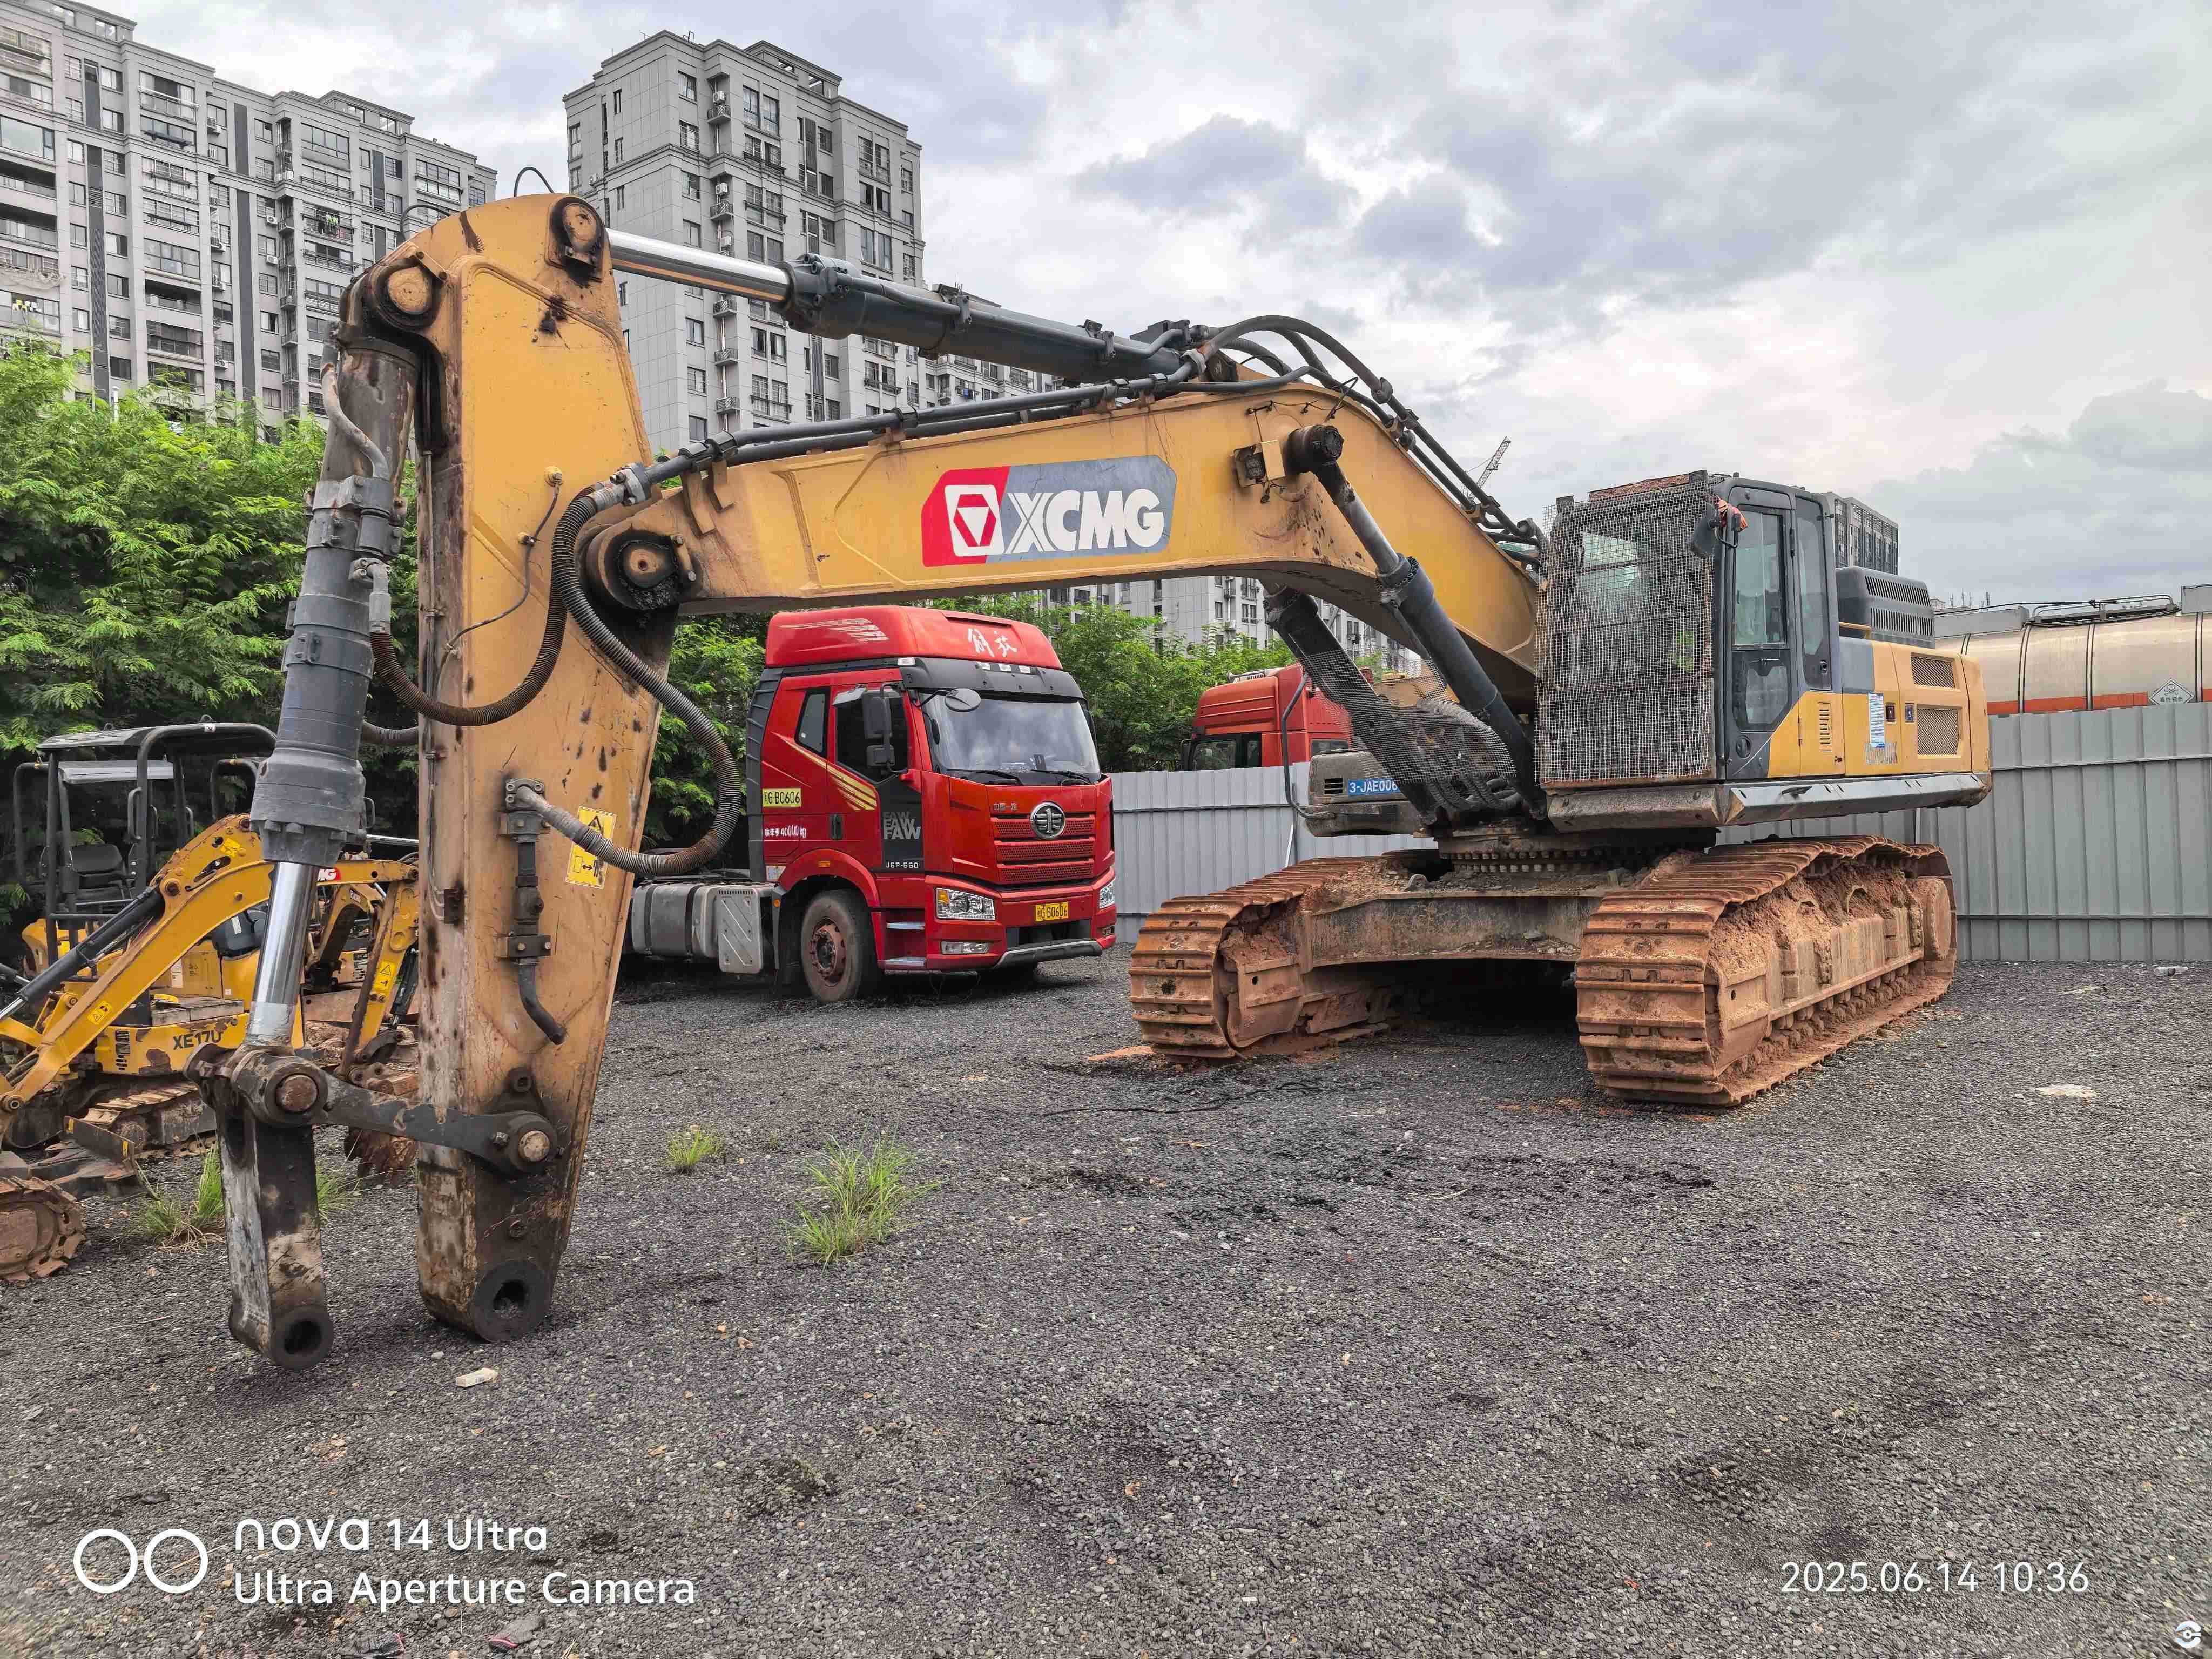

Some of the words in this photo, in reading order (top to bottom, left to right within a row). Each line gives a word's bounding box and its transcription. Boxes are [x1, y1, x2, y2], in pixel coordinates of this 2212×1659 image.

[1004, 489, 1164, 554] XCMG
[967, 628, 1017, 657] 解放
[883, 826, 921, 840] FAW
